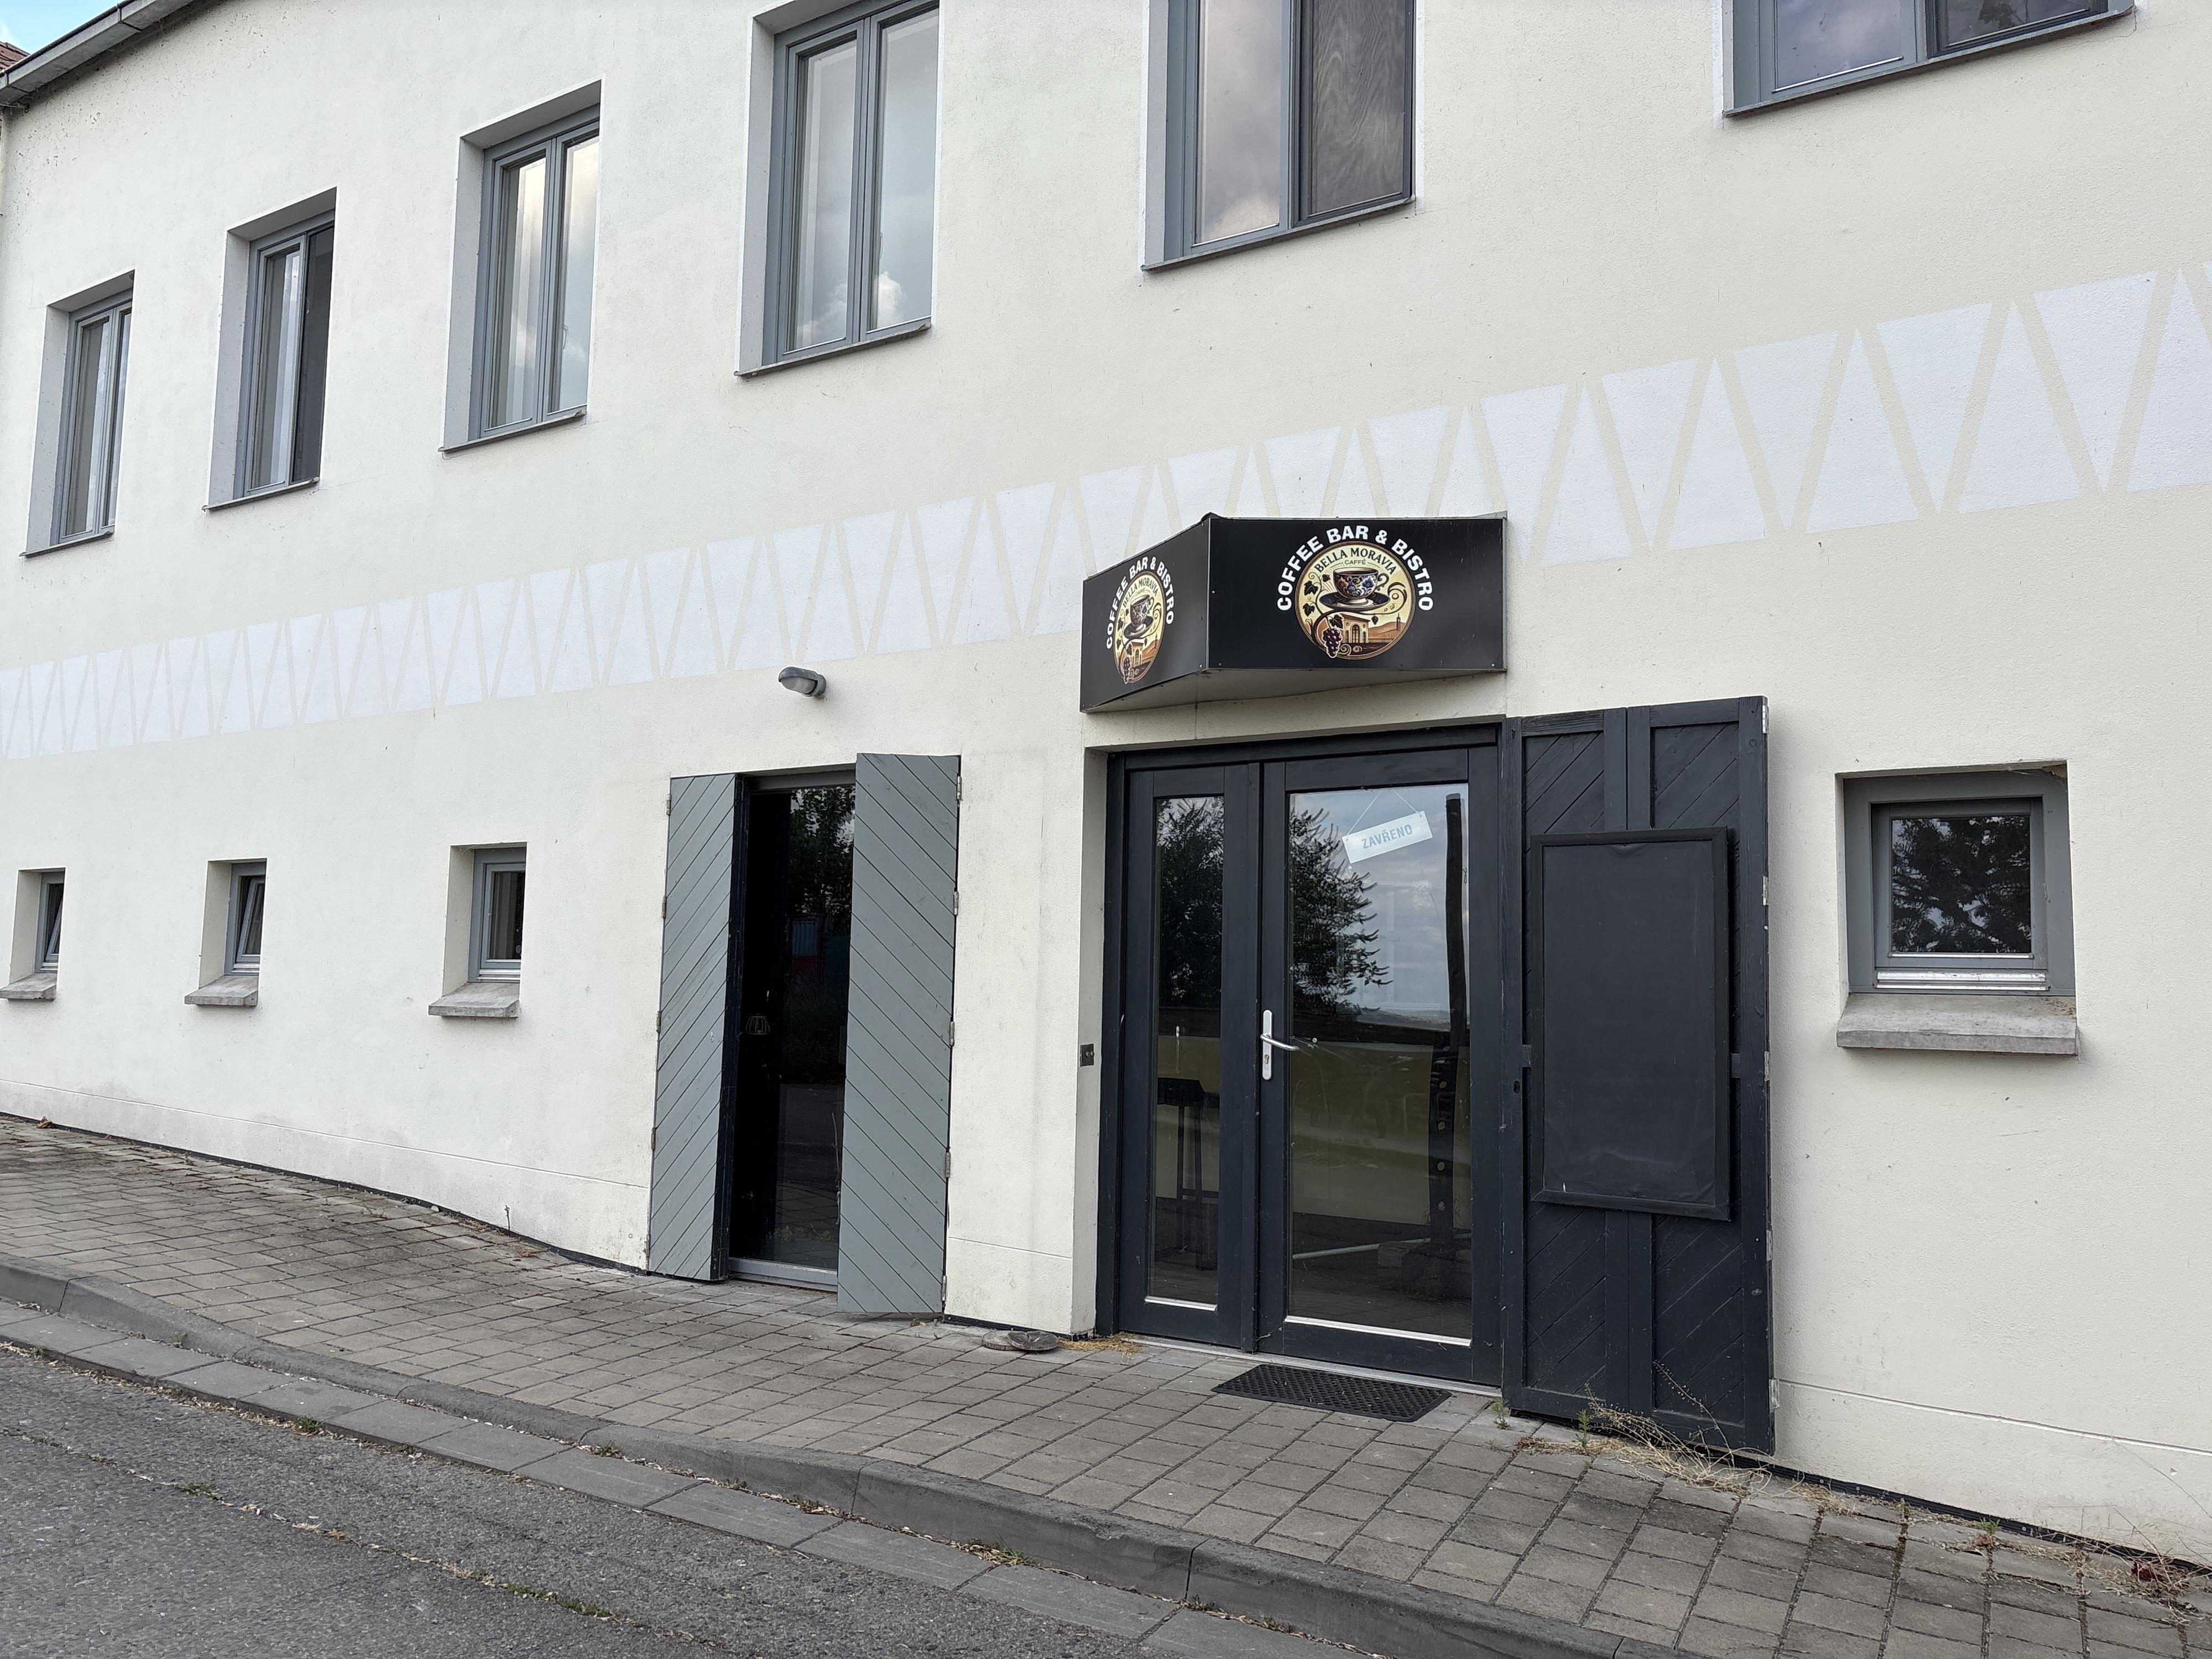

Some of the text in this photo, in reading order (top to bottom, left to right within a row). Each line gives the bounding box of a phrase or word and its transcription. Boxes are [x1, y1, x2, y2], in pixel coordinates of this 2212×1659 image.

[1277, 525, 1433, 611] COFFEE BAR & BISTRO
[1314, 547, 1397, 575] BELLA MORAVIA
[1139, 578, 1159, 597] MORAVIA
[1107, 556, 1174, 649] COFFEE BAR & BISTRO
[1361, 823, 1413, 849] ZAVŘENO
